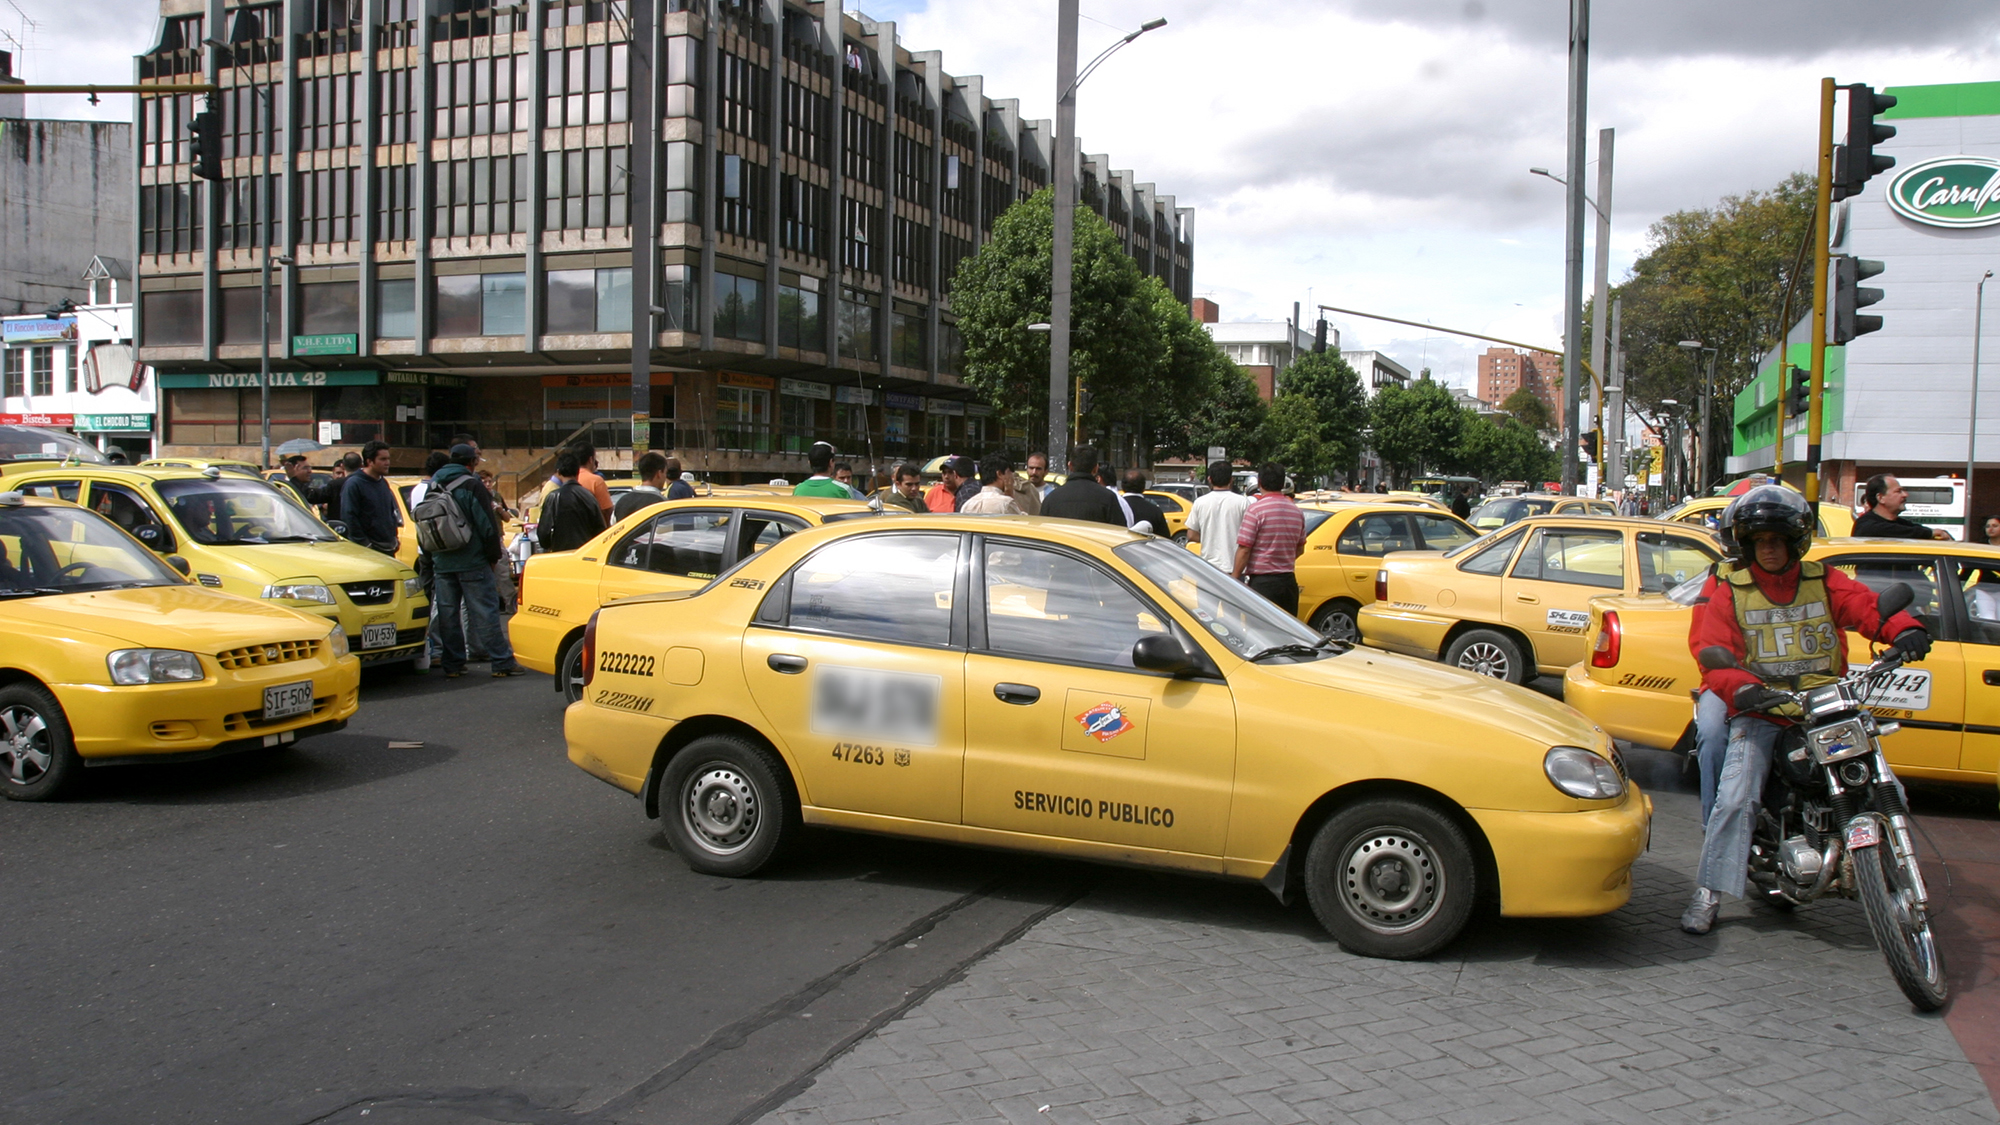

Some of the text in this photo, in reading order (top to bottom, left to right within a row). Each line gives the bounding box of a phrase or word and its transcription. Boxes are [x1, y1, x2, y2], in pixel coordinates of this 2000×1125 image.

[296, 335, 353, 347] V.H.F. LTDA
[208, 371, 327, 388] NOTARIA 42
[387, 371, 428, 384] NOTARIA 42
[22, 413, 52, 424] Bisteka
[95, 416, 102, 427] EL
[103, 416, 130, 427] CHOCOLO
[730, 577, 766, 591] 2921
[364, 627, 396, 643] VDV-539
[1799, 622, 1837, 654] 63
[600, 650, 655, 677] 2222222
[266, 686, 312, 711] SIF-509
[594, 689, 655, 712] 2.222111
[831, 742, 885, 766] 47263
[1013, 789, 1175, 828] SERVICIO PUBLICO
